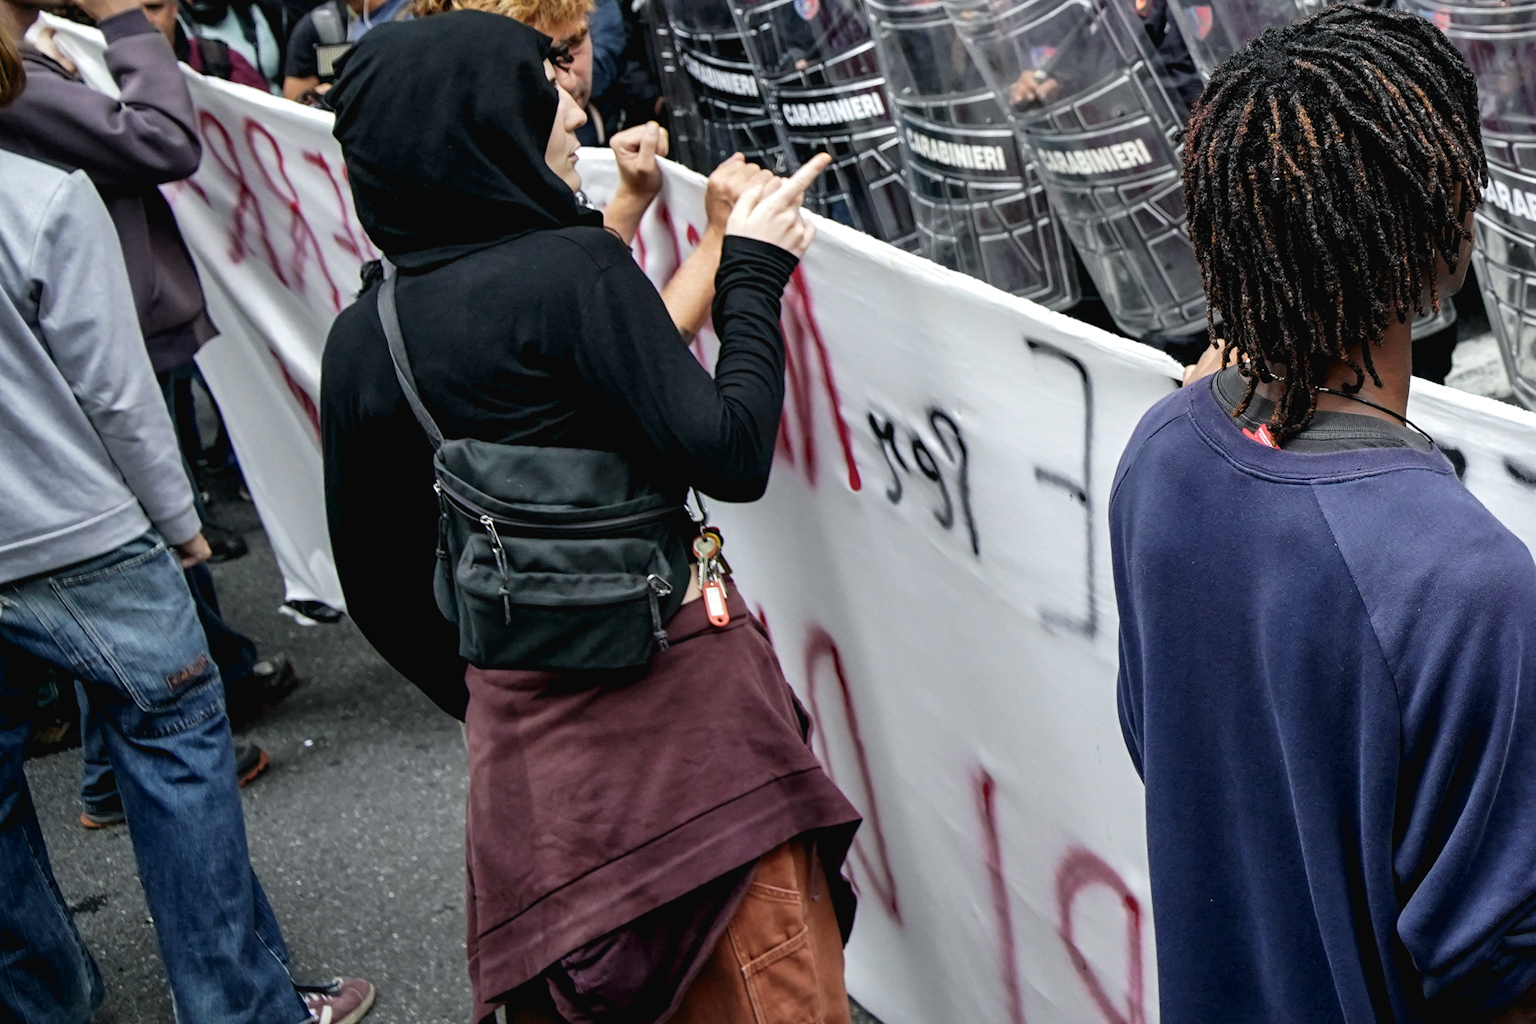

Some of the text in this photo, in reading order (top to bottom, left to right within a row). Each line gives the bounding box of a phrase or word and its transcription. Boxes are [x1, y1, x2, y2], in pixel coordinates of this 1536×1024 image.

[782, 91, 886, 128] CARABINIERI
[905, 125, 1008, 171] CARABINIERI
[1036, 137, 1153, 175] CARABINIERI
